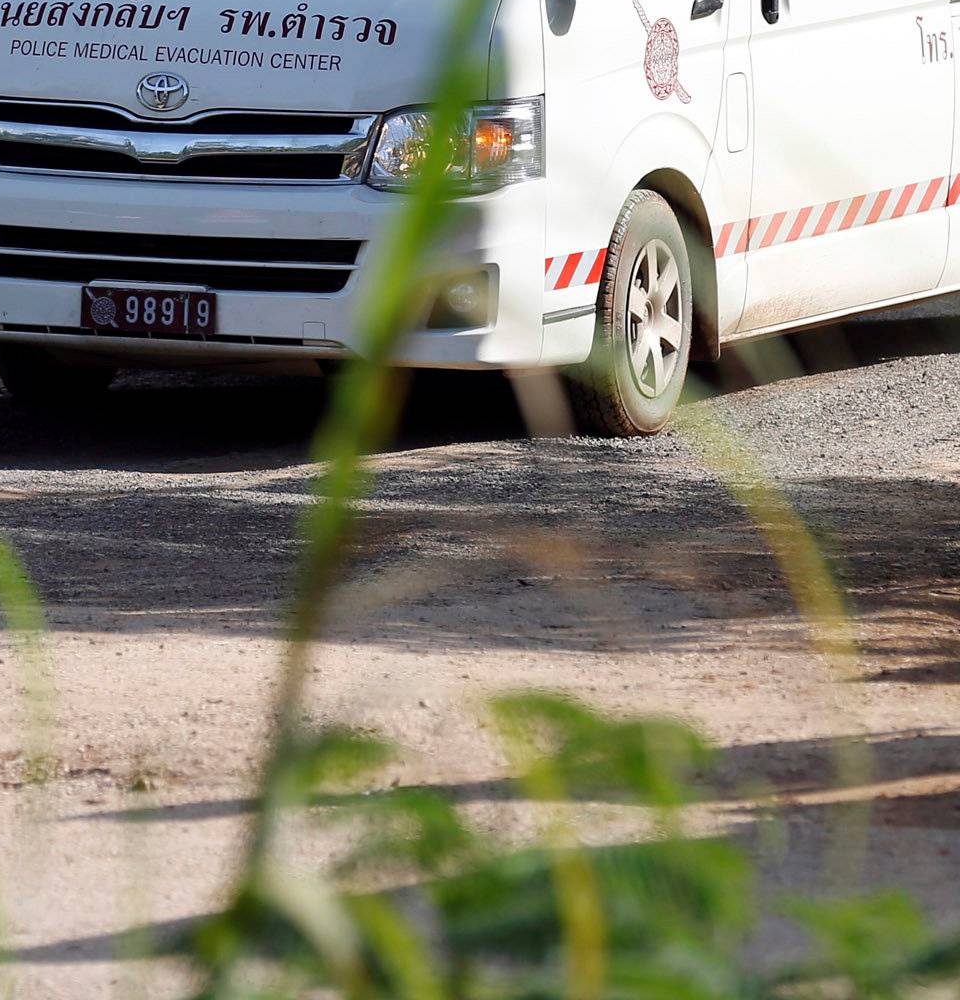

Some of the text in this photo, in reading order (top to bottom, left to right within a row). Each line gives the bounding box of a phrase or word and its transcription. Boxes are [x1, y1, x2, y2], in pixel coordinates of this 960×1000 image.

[219, 2, 398, 46] รพ.ตำรวจ
[915, 16, 954, 65] โทร.
[10, 39, 342, 72] POLICE MEDICAL EVACUATION CENTER
